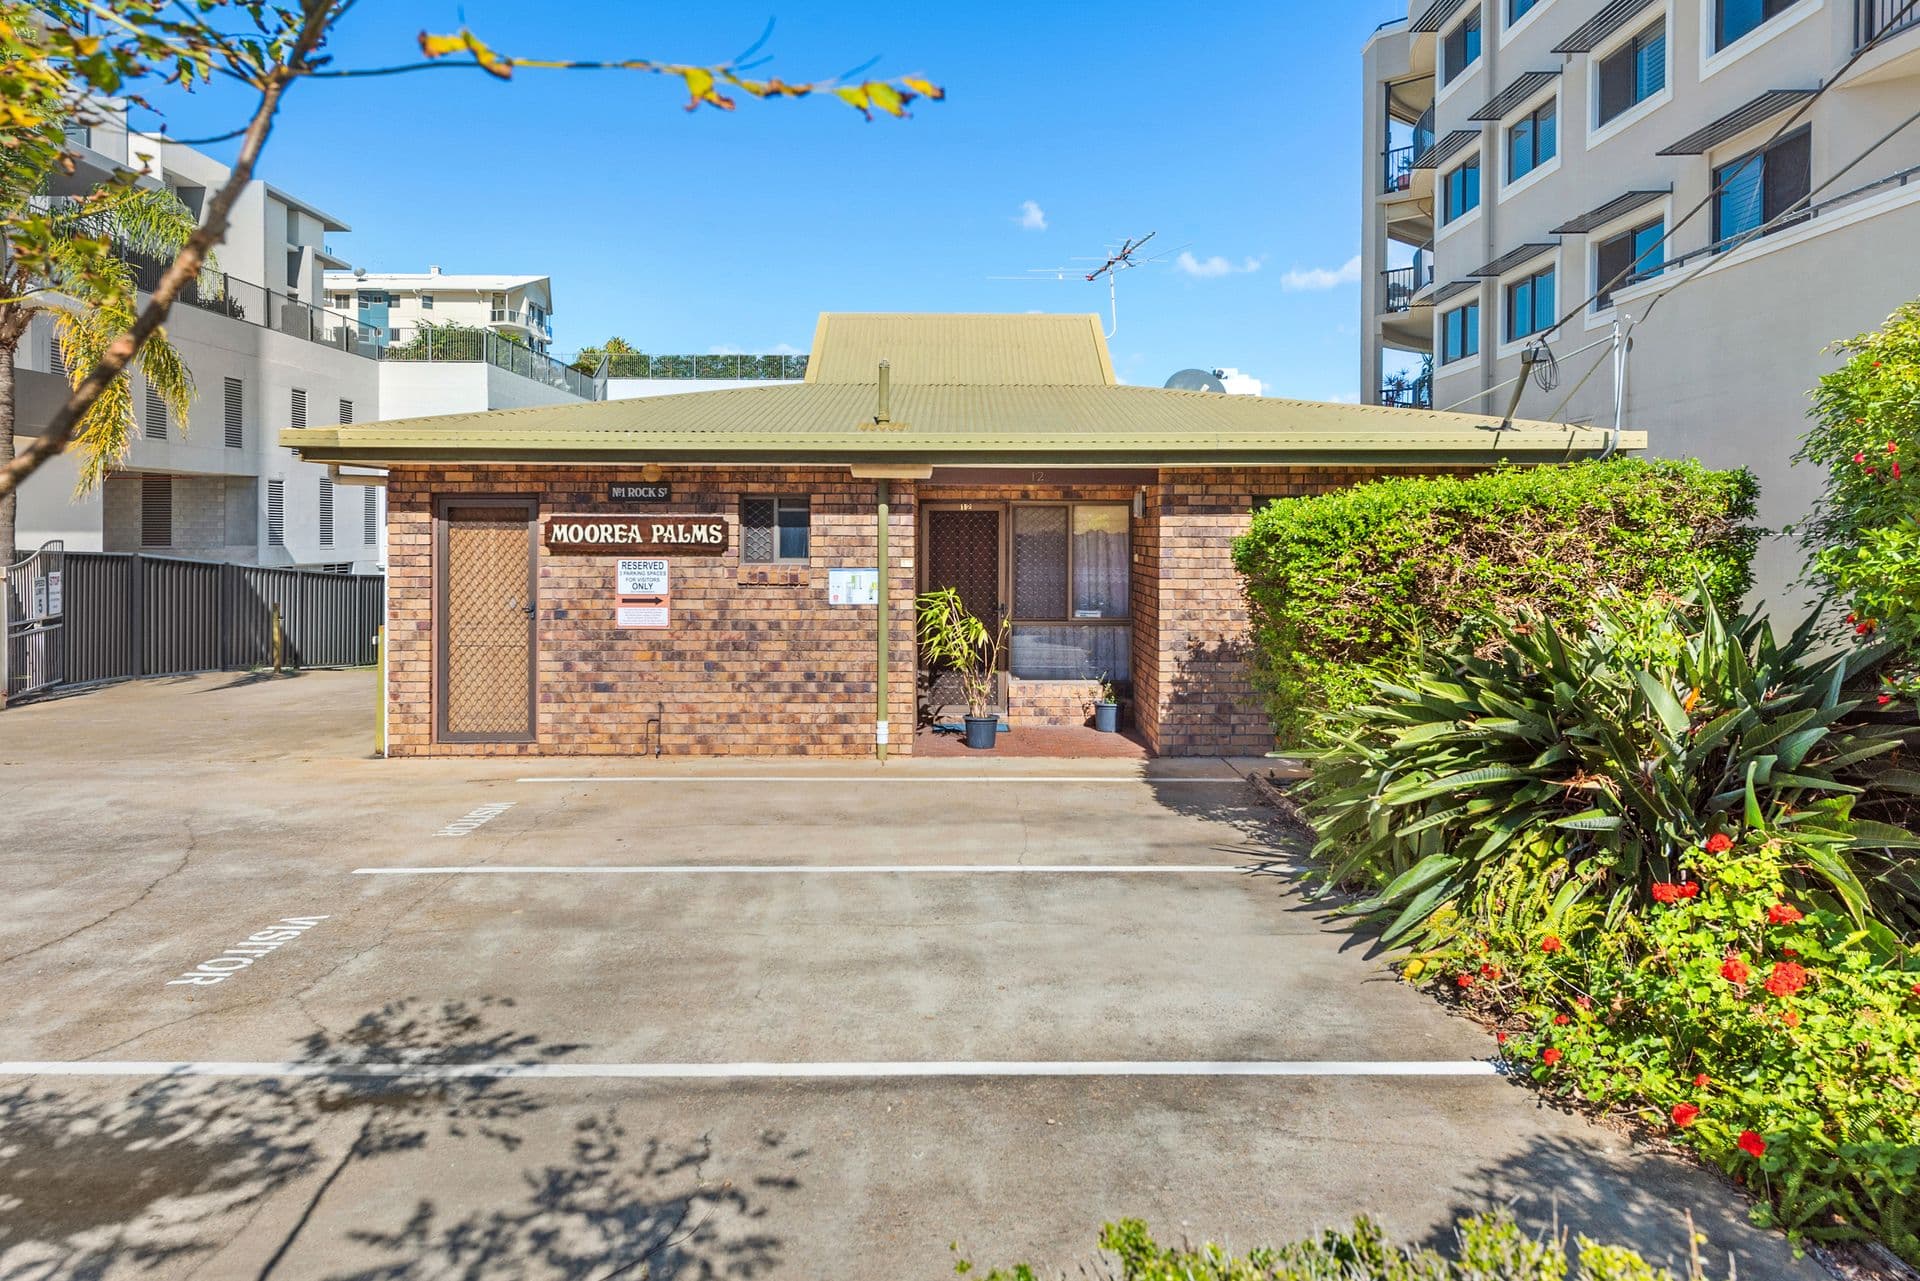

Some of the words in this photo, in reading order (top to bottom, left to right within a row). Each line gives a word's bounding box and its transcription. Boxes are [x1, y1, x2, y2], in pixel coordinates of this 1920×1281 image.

[628, 487, 656, 498] ROCK
[551, 524, 643, 544] MOOREA
[651, 524, 723, 544] PALMS
[621, 561, 664, 570] RESERVED
[166, 914, 331, 986] VISITOR
